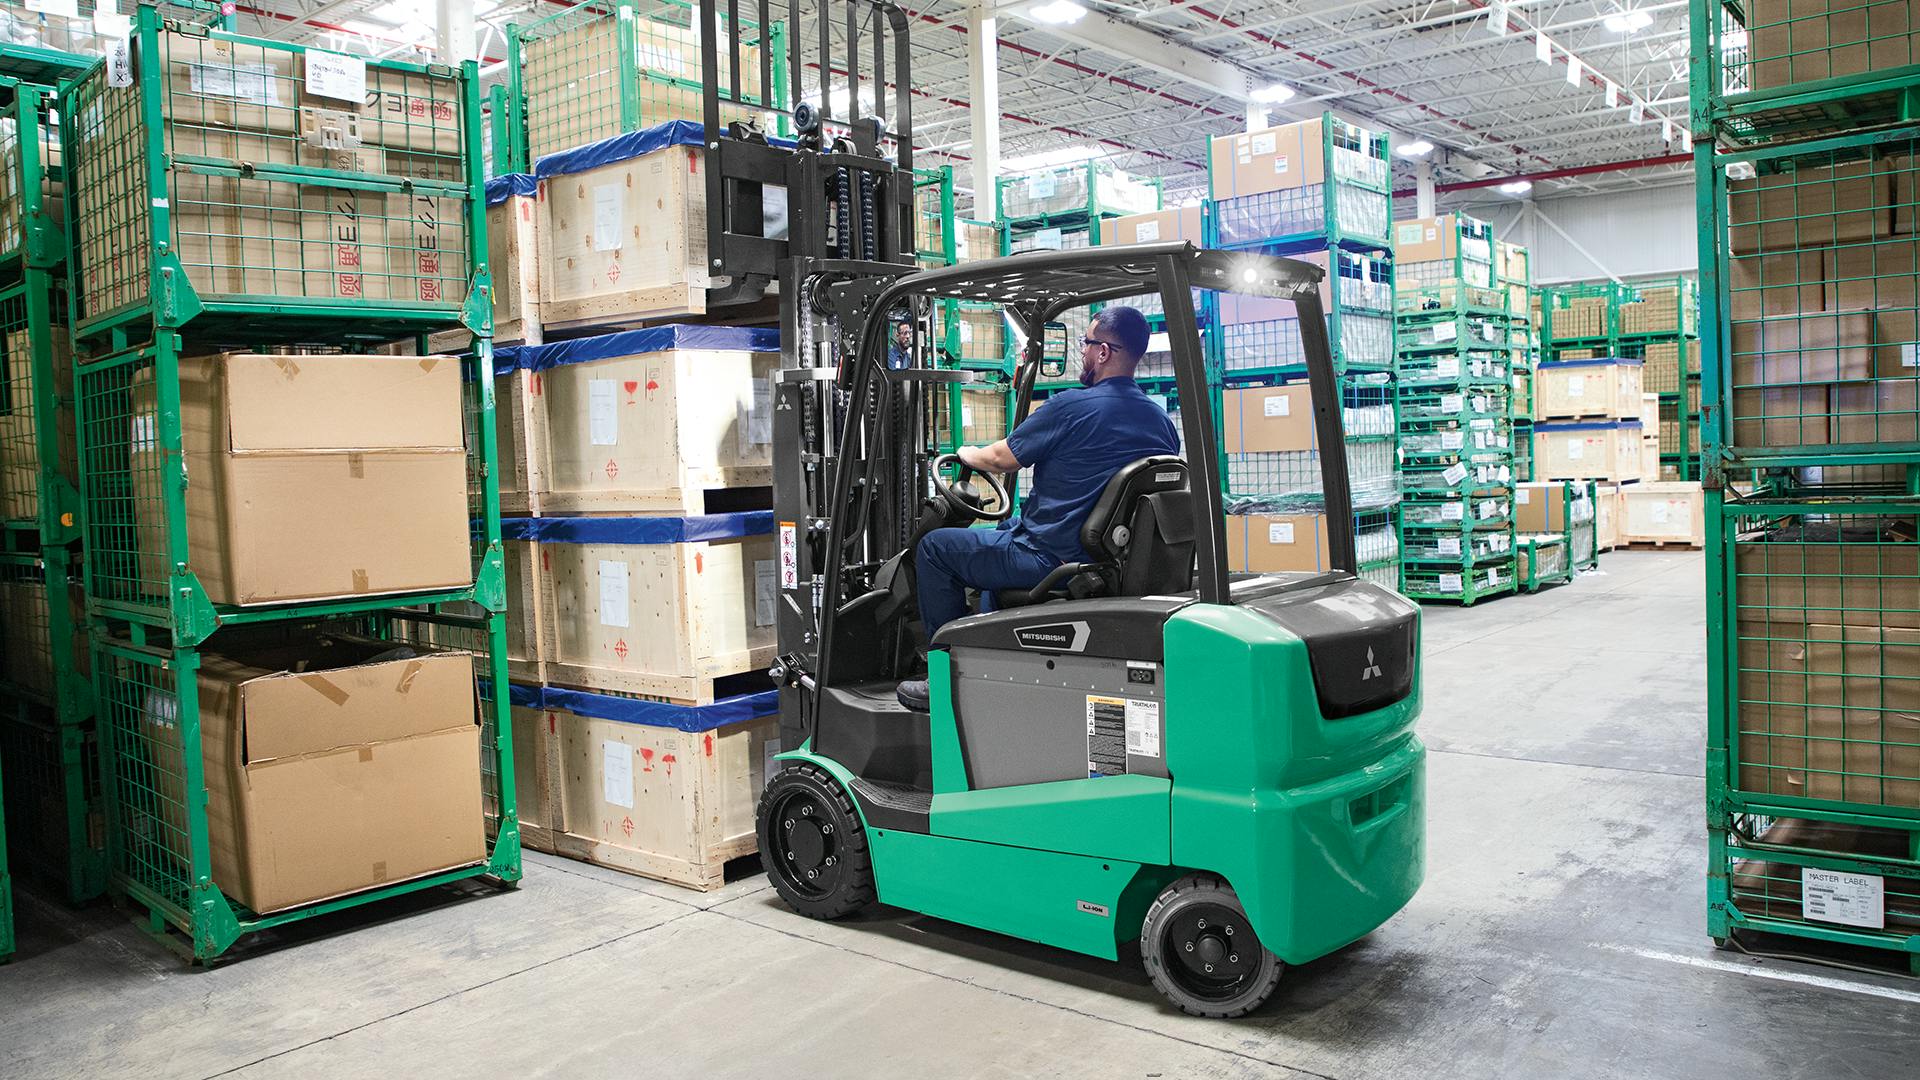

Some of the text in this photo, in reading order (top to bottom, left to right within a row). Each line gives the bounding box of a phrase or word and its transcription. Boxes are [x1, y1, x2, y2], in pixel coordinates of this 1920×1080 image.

[1693, 107, 1709, 123] A4
[1021, 633, 1067, 642] MITSUBISHI
[1808, 872, 1869, 887] MASTER LABEL
